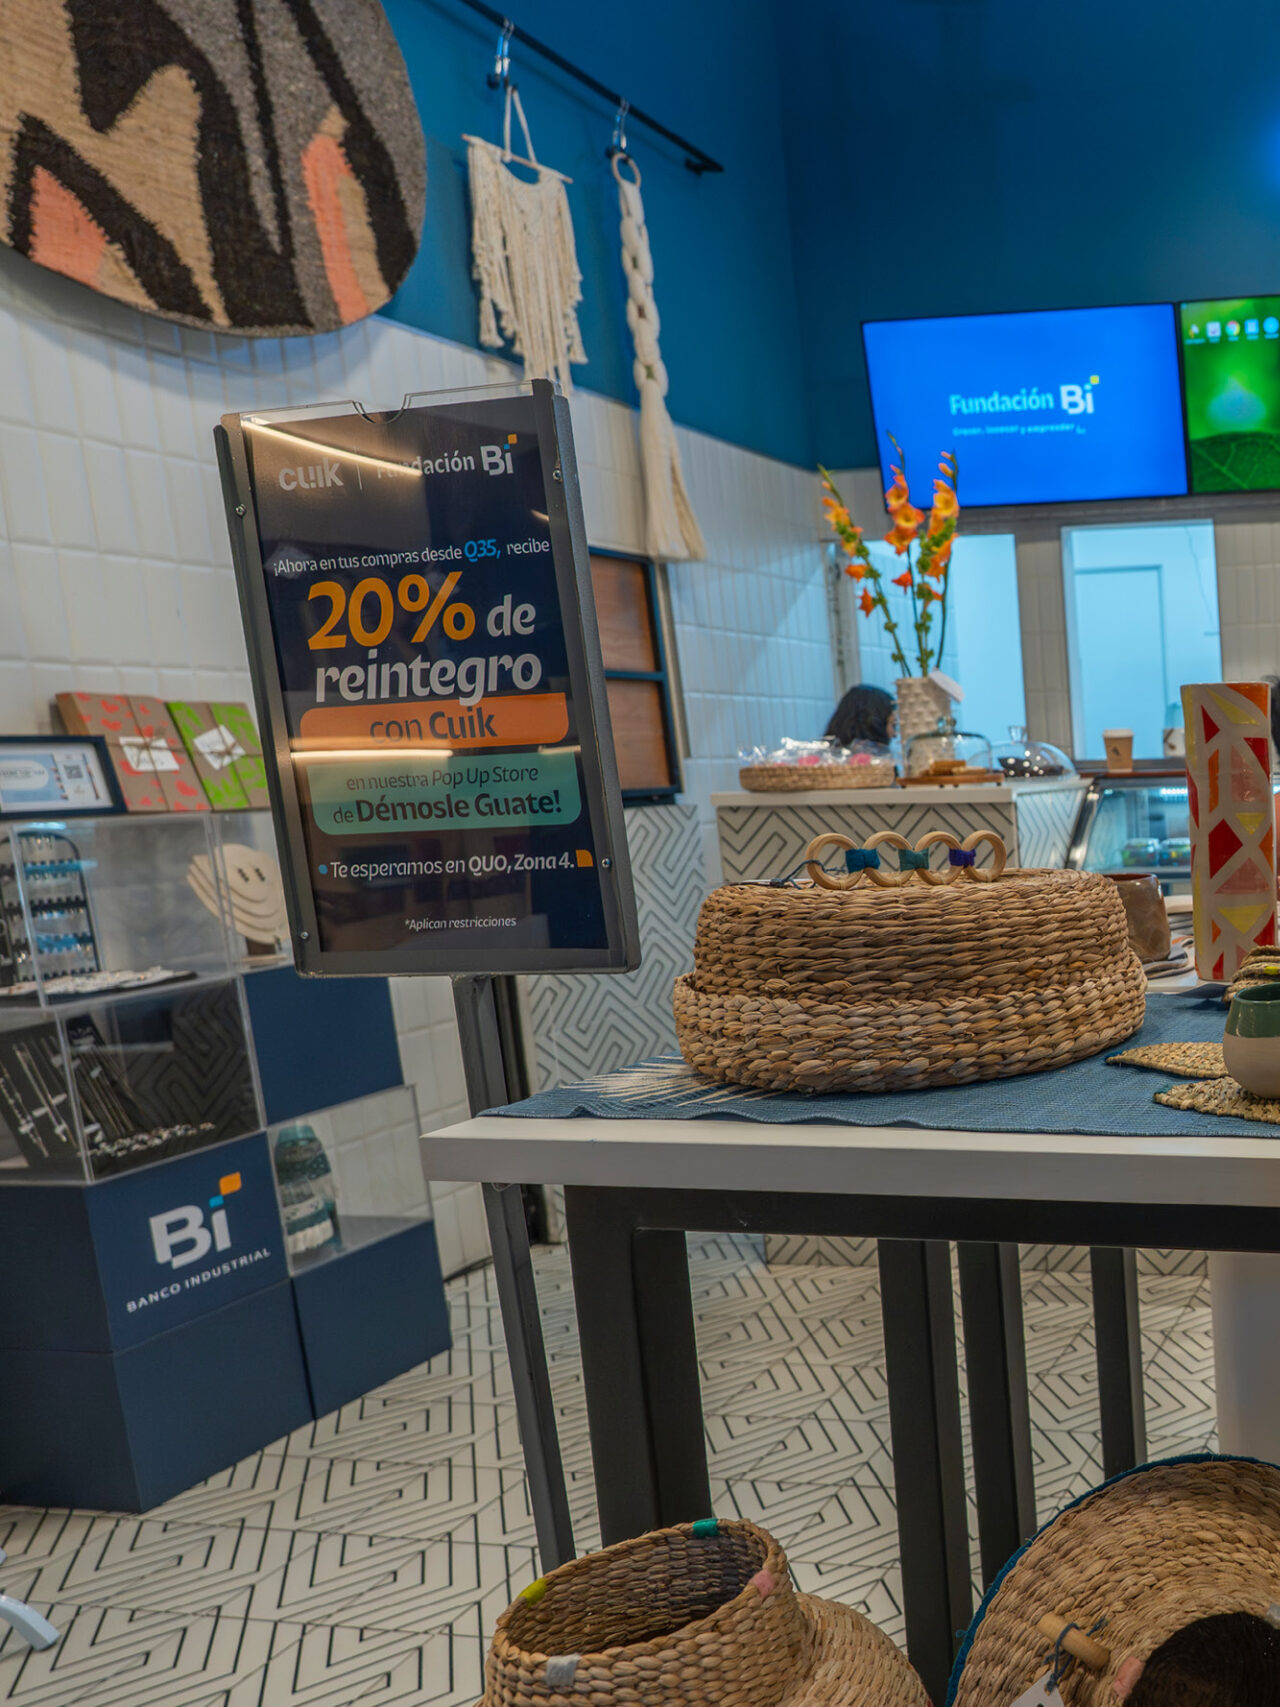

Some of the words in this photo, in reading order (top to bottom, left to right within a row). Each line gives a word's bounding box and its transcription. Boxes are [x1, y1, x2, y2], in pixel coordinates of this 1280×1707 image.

[949, 387, 1054, 415] Fundación
[1059, 382, 1094, 414] Bi
[480, 443, 514, 476] Bi
[273, 557, 318, 576] ¡Ahora
[319, 559, 337, 570] en
[338, 555, 359, 569] tus
[361, 550, 419, 569] compras
[421, 546, 462, 561] desde
[464, 539, 501, 562] Q35,
[506, 539, 550, 555] recibe
[307, 571, 476, 650] 20%
[486, 594, 537, 638] de
[315, 649, 543, 706] reintegro
[369, 718, 423, 744] con
[428, 706, 498, 740] Cuik
[346, 776, 366, 790] en
[367, 771, 428, 789] nuestra
[432, 768, 464, 789] Pop
[466, 766, 490, 784] Up
[494, 766, 539, 782] Store
[333, 807, 355, 824] de
[356, 795, 471, 822] Démosle
[474, 789, 563, 816] Guate!
[330, 862, 349, 878] Te
[350, 859, 442, 881] esperamos
[445, 861, 466, 874] en
[468, 854, 512, 877] QUO,
[513, 853, 557, 871] Zona
[558, 852, 575, 869] 4.
[449, 916, 518, 929] restricciones
[149, 1194, 232, 1271] Bi
[126, 1282, 182, 1313] BANCO
[184, 1247, 271, 1290] INDUSTRIAL
